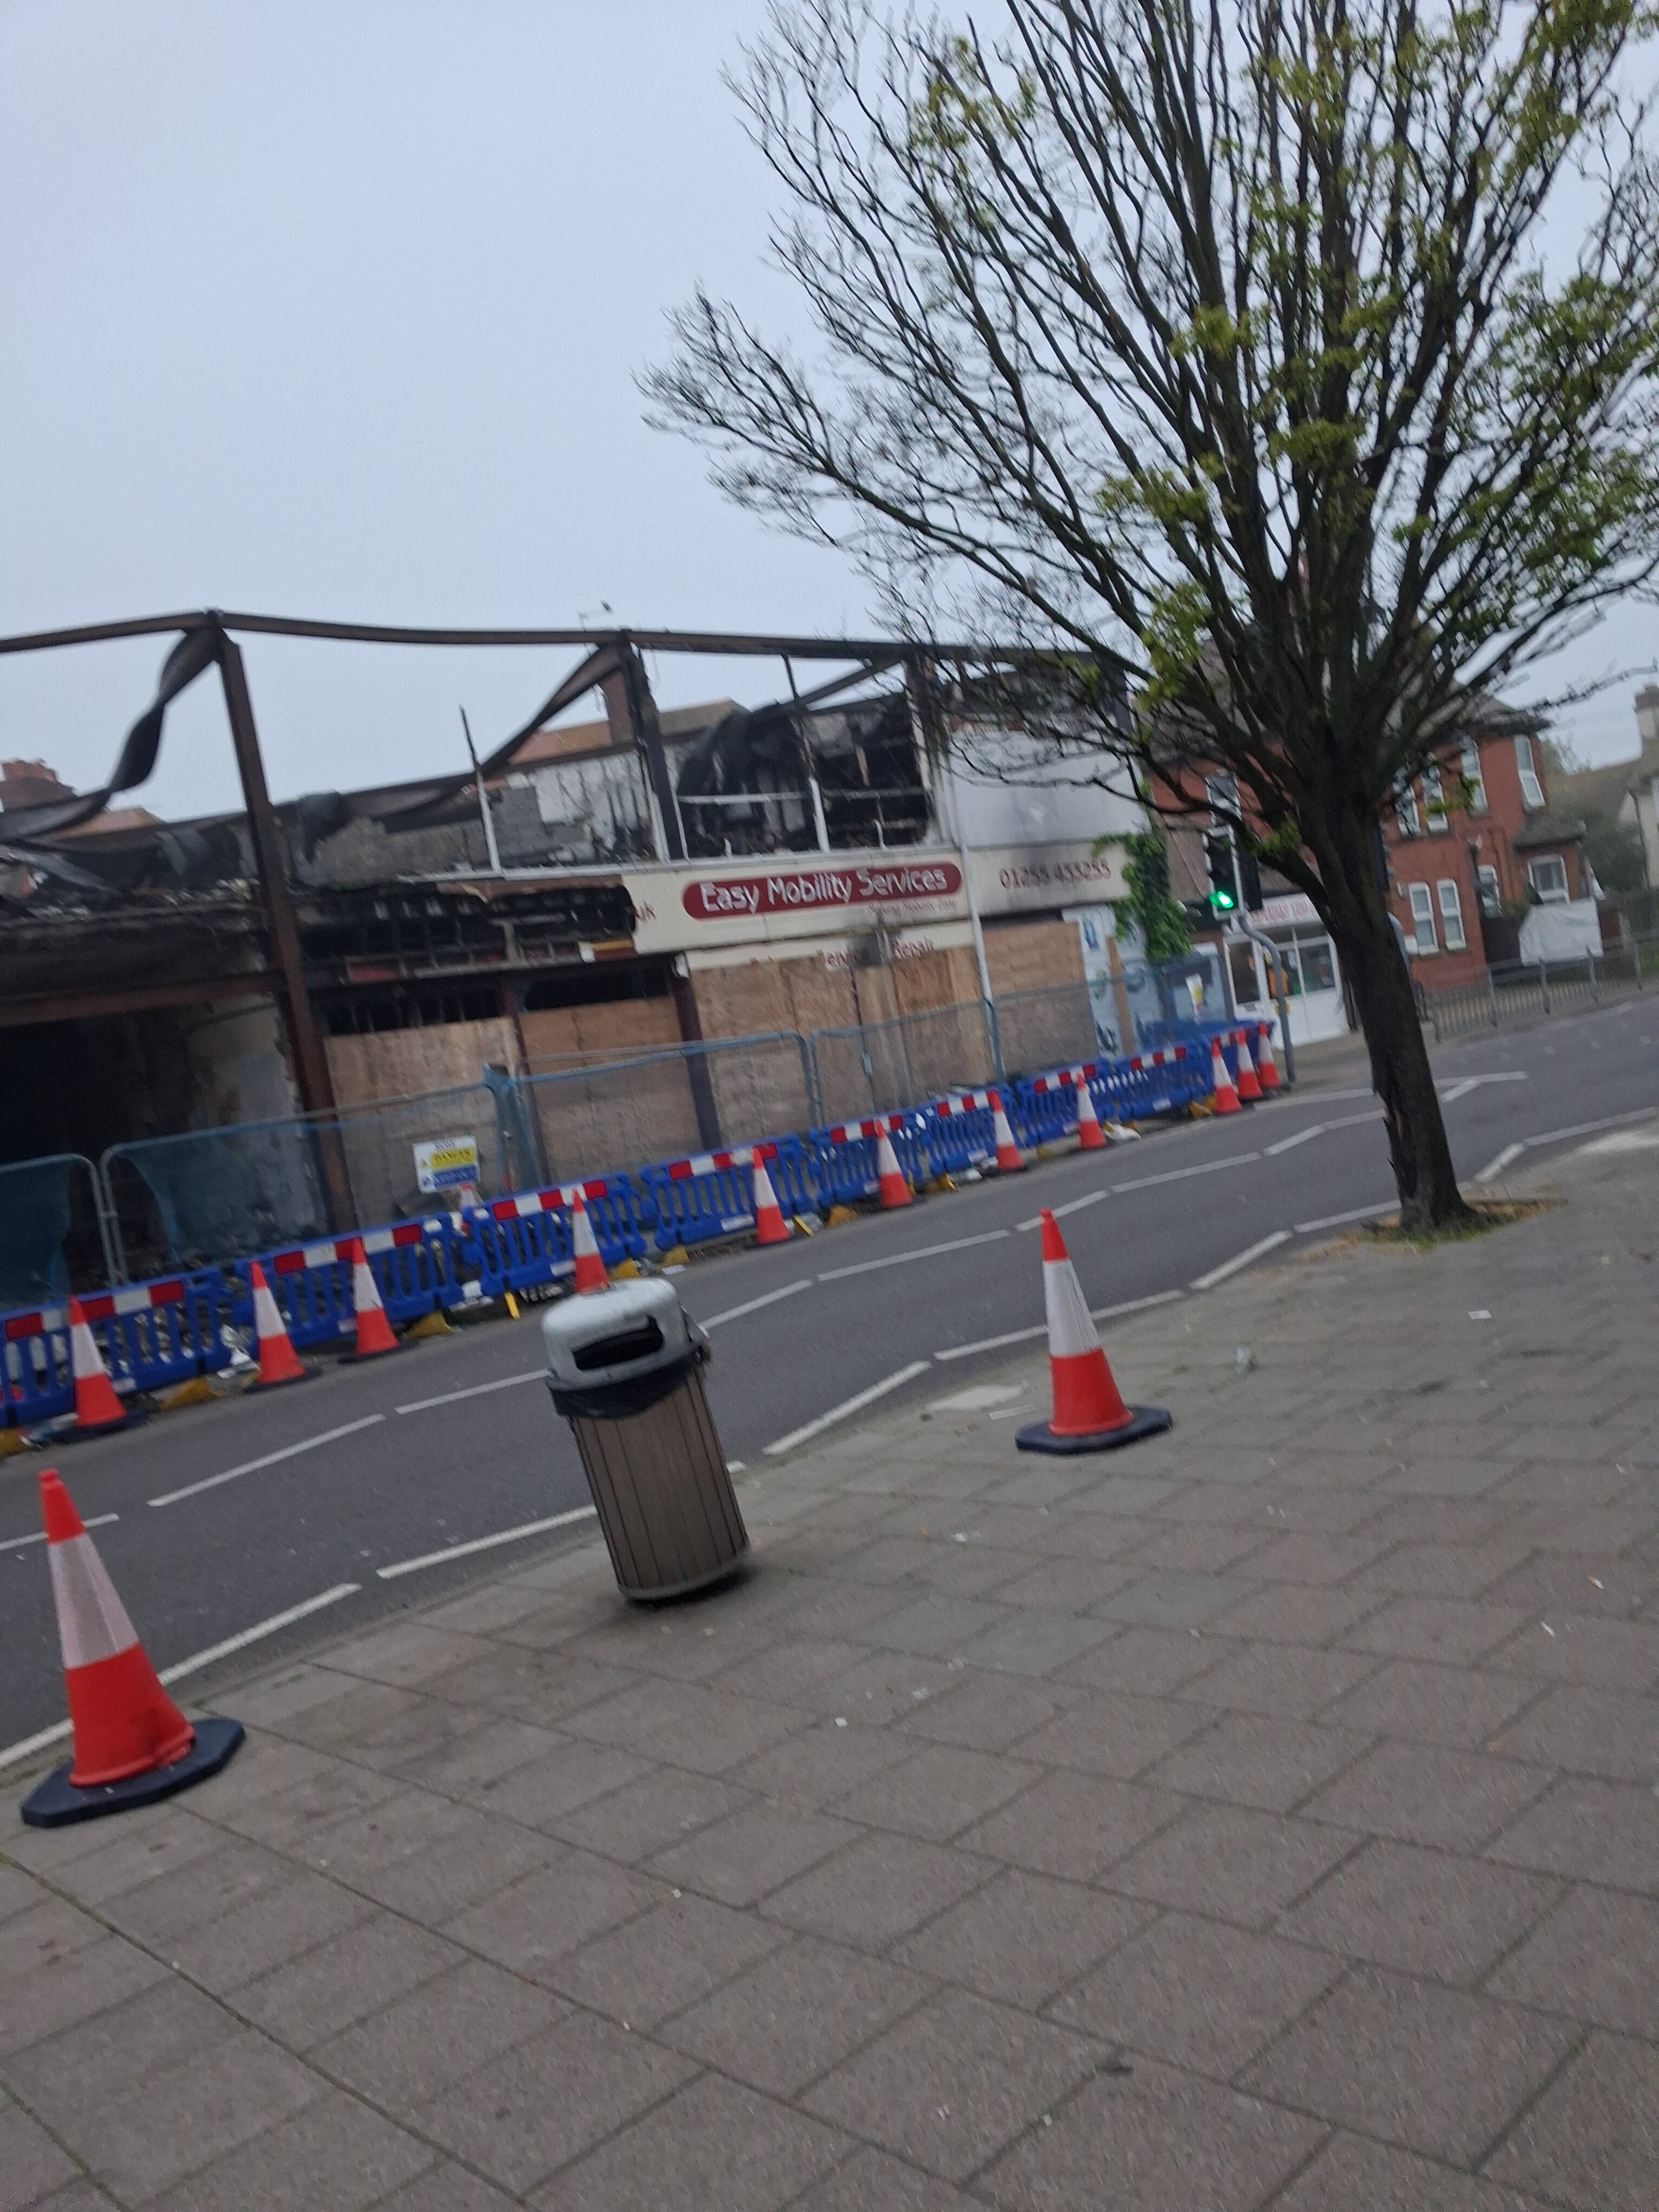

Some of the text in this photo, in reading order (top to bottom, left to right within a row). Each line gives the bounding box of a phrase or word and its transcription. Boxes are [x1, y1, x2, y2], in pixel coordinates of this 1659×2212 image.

[699, 869, 948, 914] Easy Mobility Services
